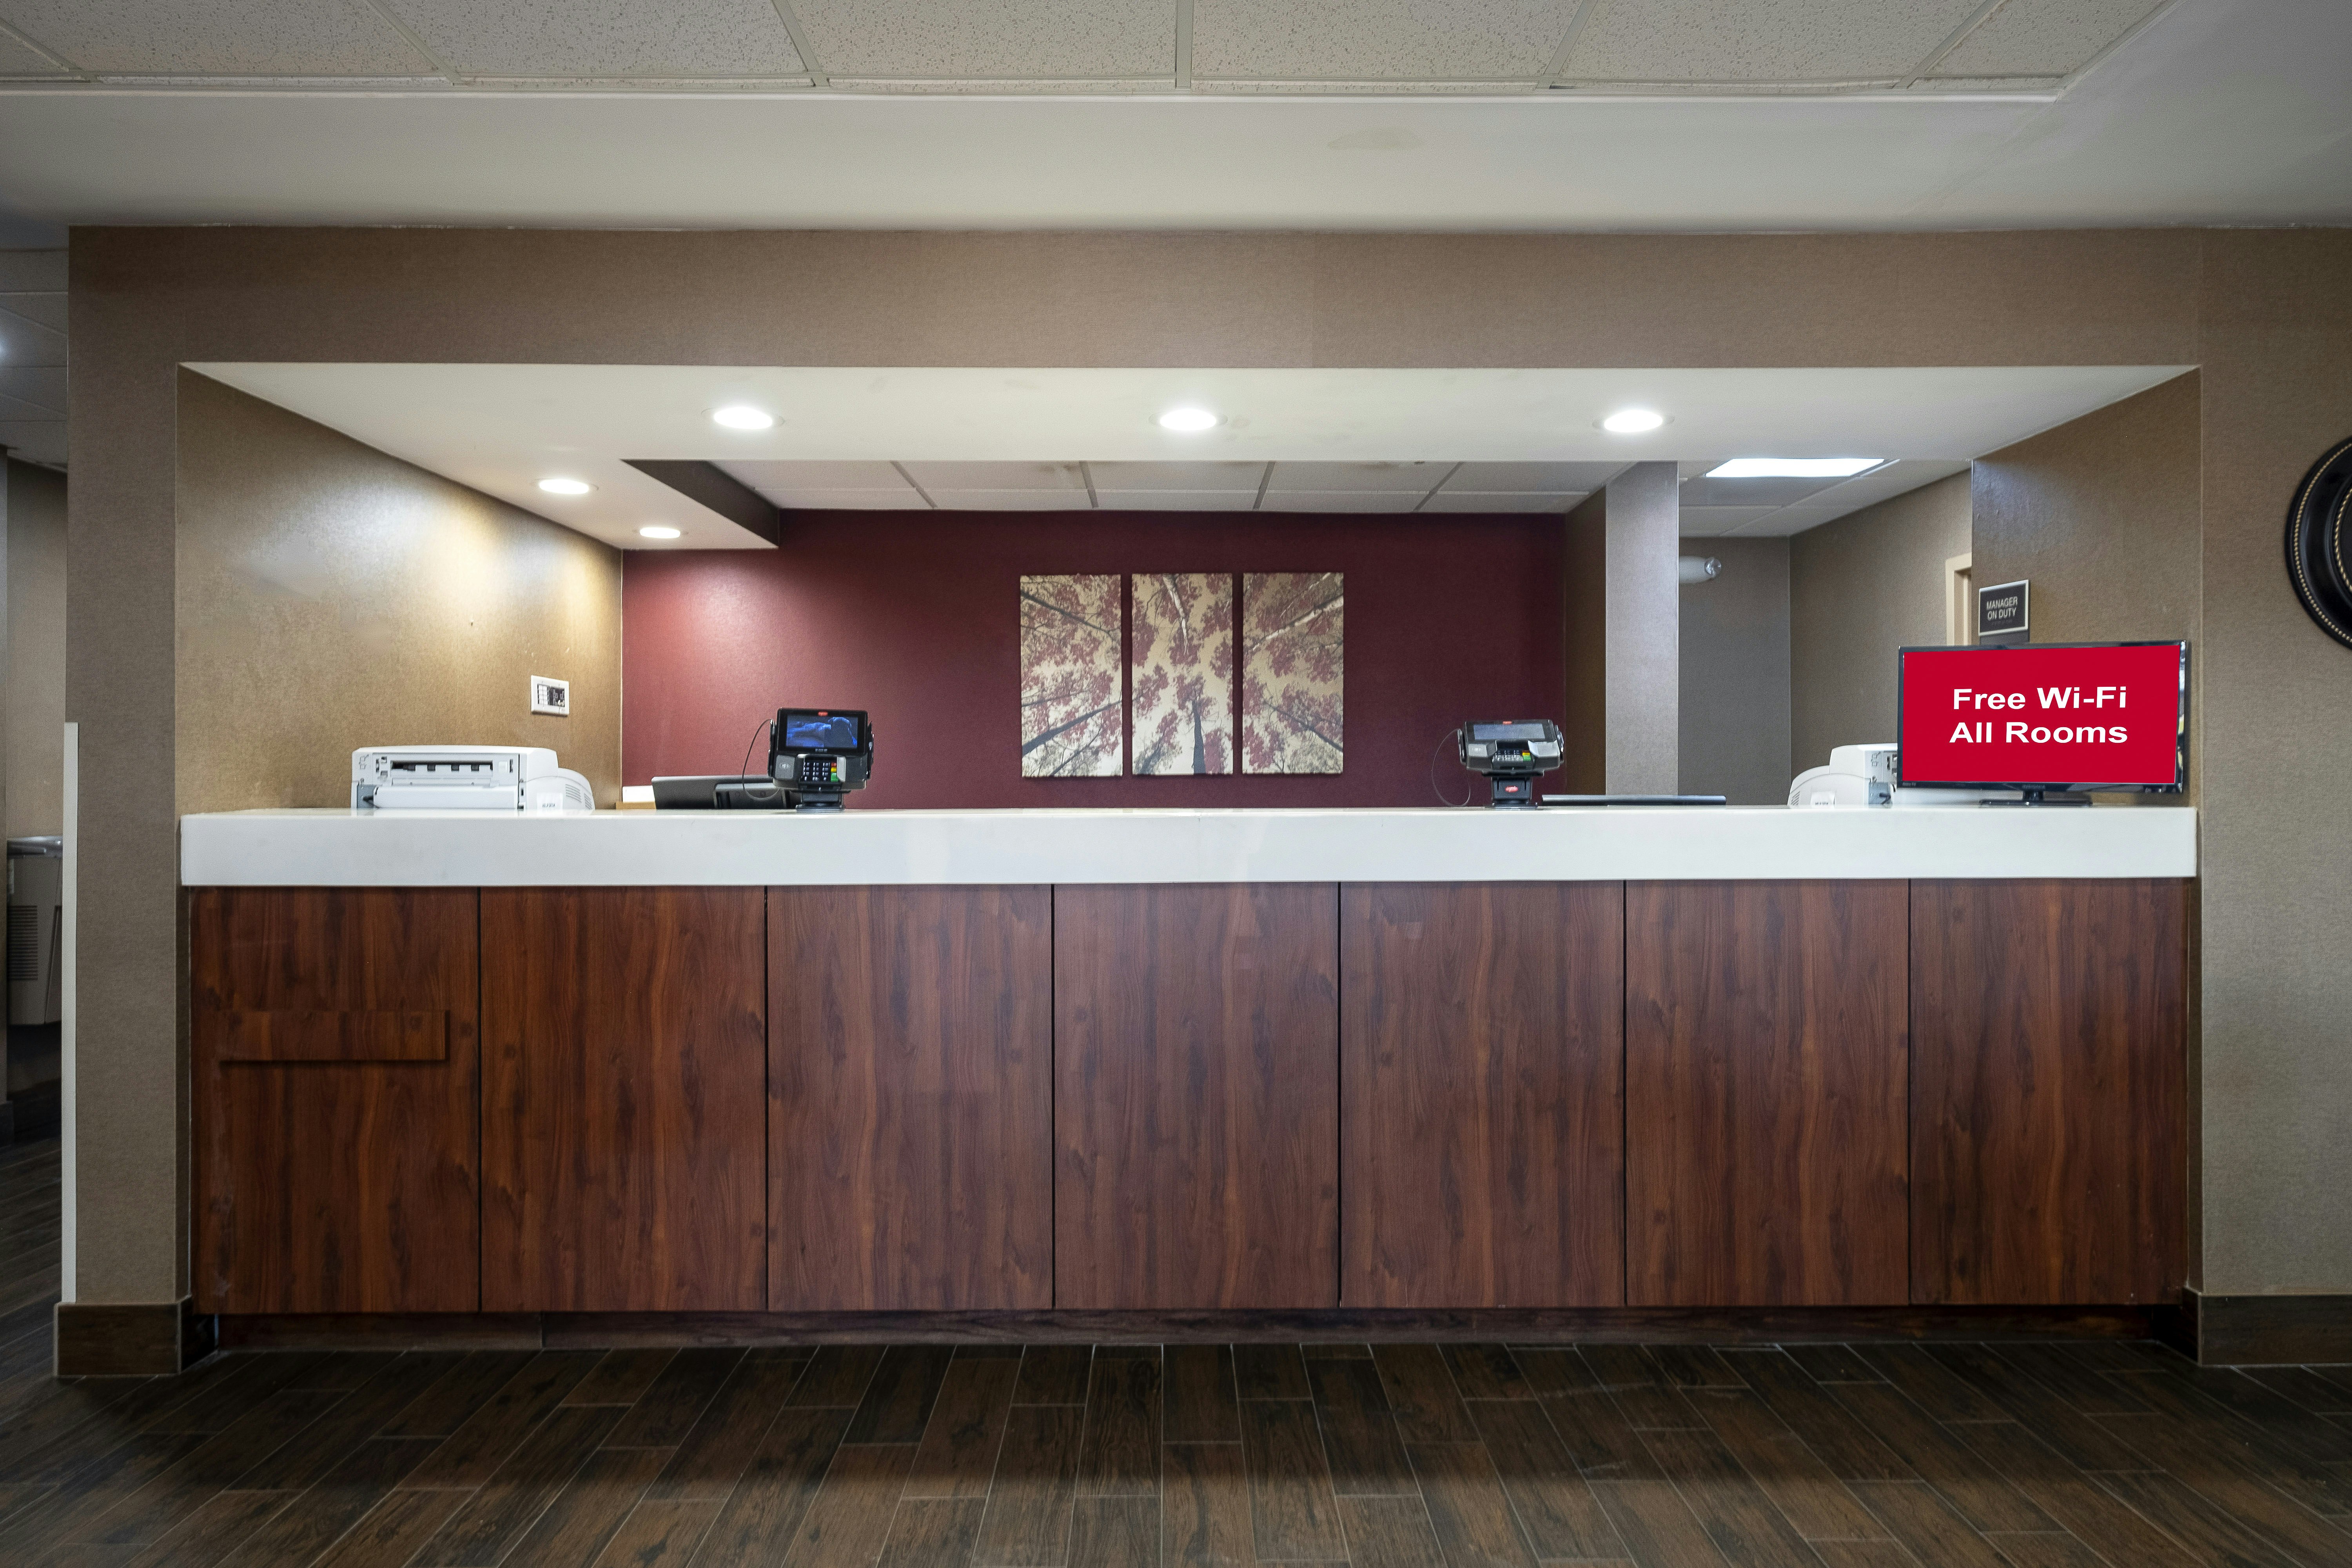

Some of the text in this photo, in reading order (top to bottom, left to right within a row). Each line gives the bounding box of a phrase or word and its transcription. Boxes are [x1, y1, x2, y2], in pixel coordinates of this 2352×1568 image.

[1986, 596, 2018, 610] MANAGER
[1987, 607, 2016, 621] ON DUTY
[1953, 686, 2127, 710] Free Wi-Fi
[1949, 722, 2128, 743] All Rooms
